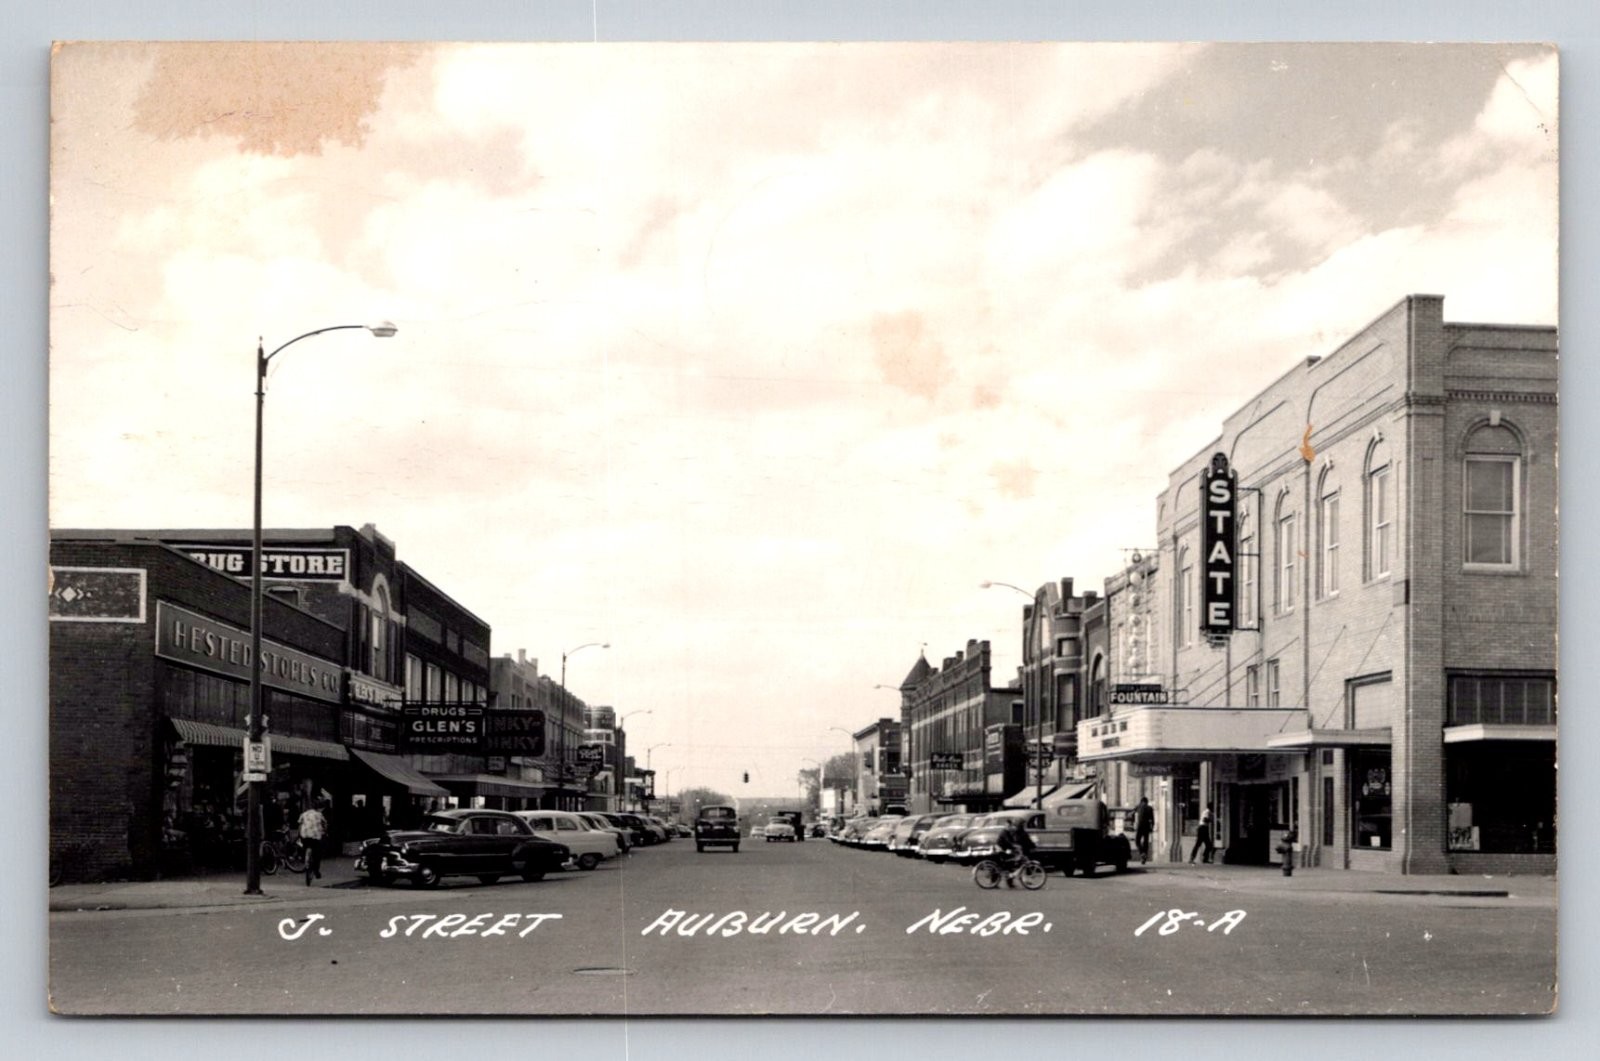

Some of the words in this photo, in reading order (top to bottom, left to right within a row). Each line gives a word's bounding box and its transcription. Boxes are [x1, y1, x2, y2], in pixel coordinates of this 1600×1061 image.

[1208, 479, 1232, 626] STATE
[260, 650, 318, 687] STORES
[1110, 691, 1167, 703] FOUNTAIN
[421, 707, 467, 717] DRUGS
[412, 719, 476, 733] GLEN'S
[409, 736, 478, 744] PRESCRIPTIONS
